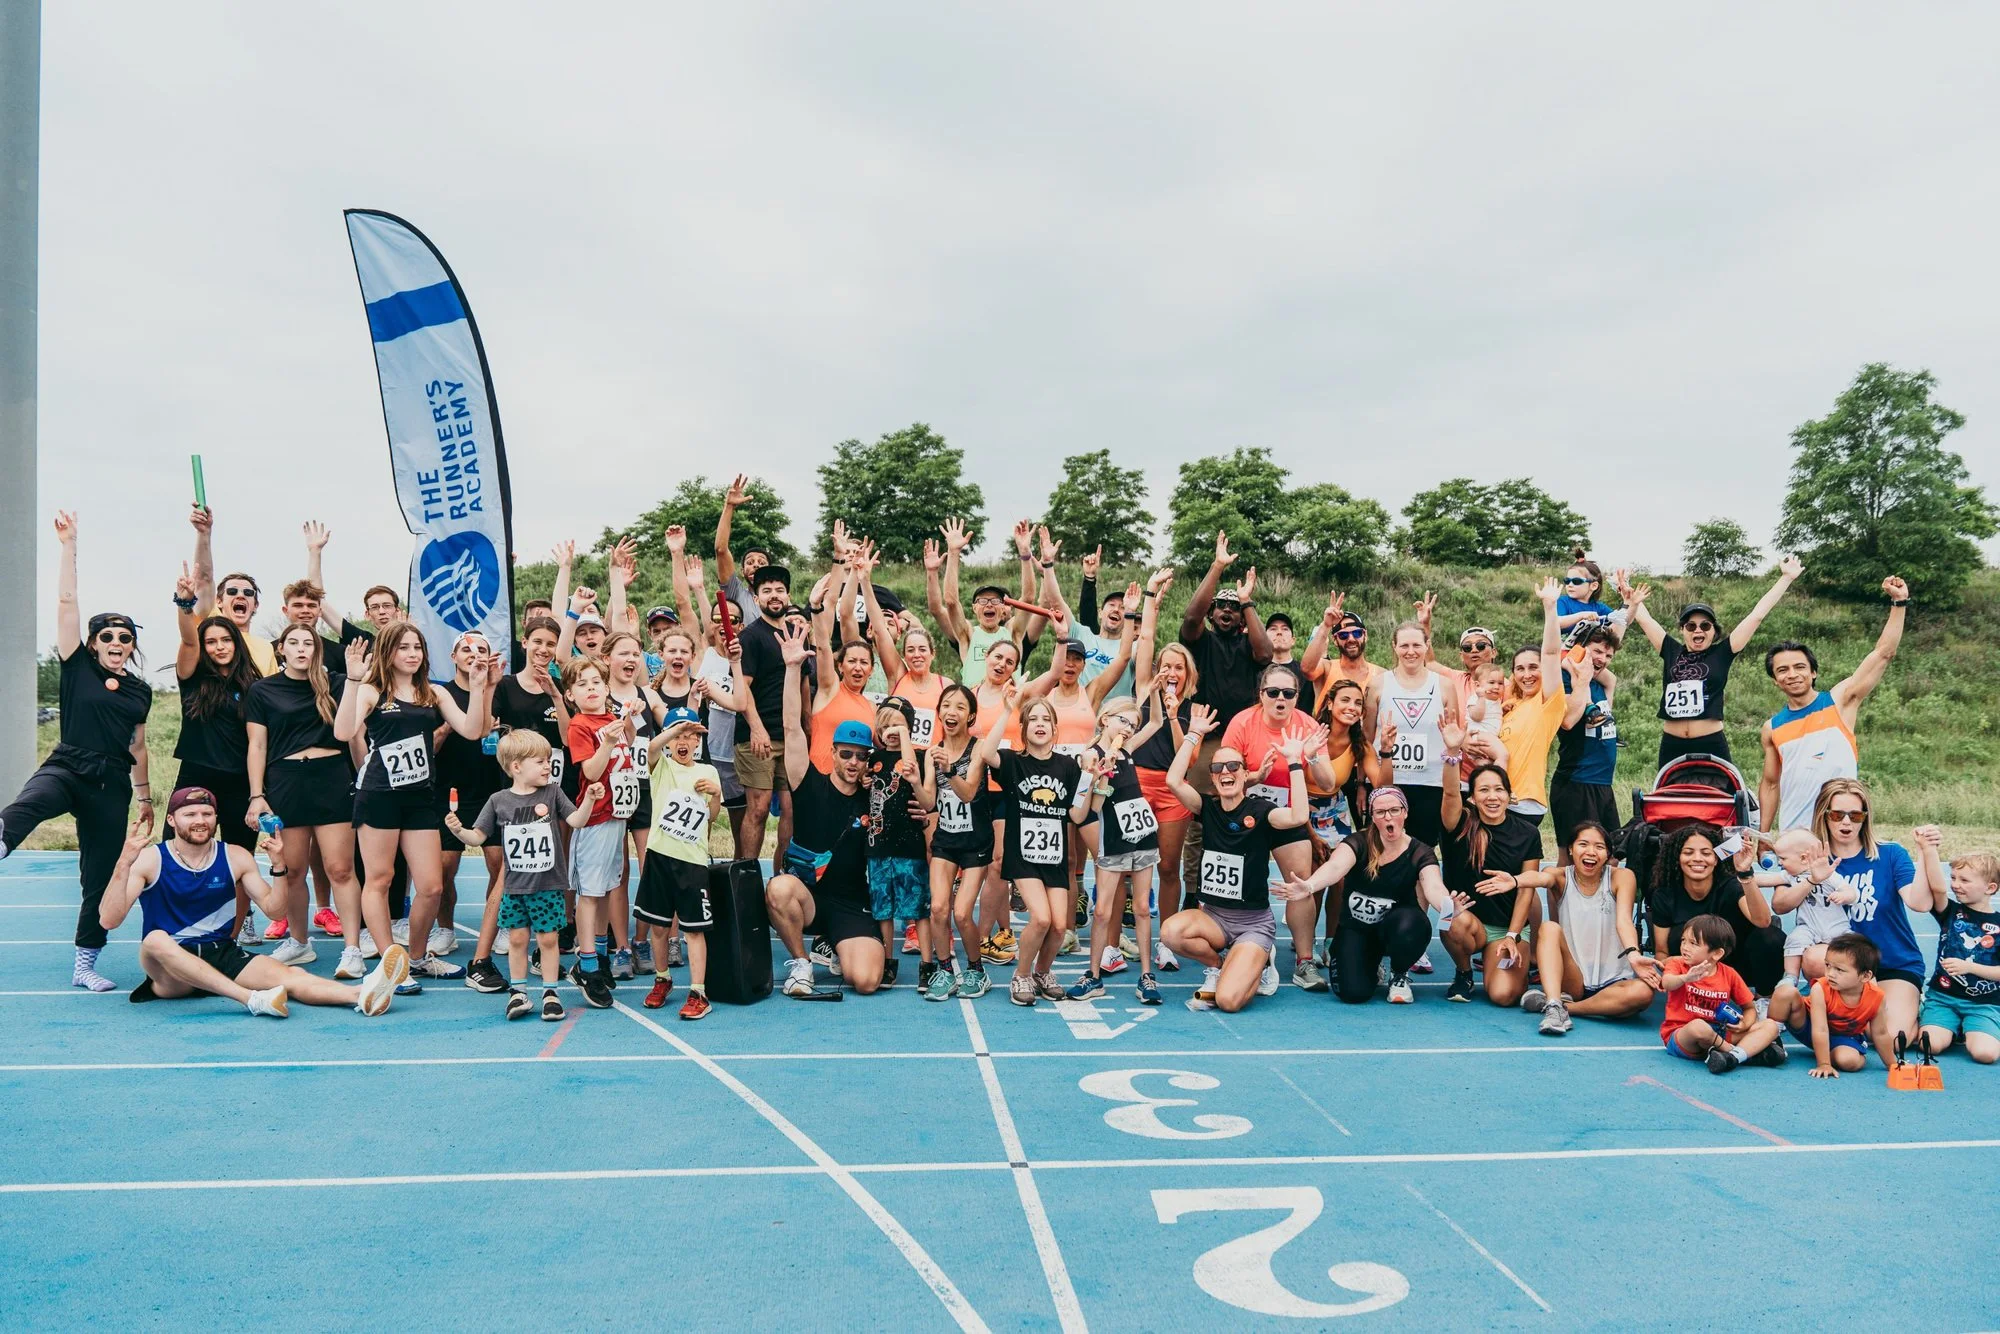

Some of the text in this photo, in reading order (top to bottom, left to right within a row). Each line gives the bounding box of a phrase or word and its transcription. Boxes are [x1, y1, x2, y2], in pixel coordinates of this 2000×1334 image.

[425, 379, 467, 520] RUNNER'S
[446, 381, 483, 513] ACADEMY
[417, 469, 444, 524] THE
[1667, 689, 1698, 708] 251
[911, 718, 932, 736] 89
[387, 747, 426, 775] 218
[1391, 743, 1424, 762] 200
[1018, 774, 1068, 801] BISONS
[662, 801, 706, 831] 247
[1019, 800, 1067, 816] TRACK CLUB
[1121, 808, 1154, 834] 236
[673, 829, 685, 838] FOR
[1023, 830, 1060, 852] 234
[508, 836, 551, 860] 244
[1203, 862, 1239, 887] 255
[700, 888, 713, 920] FILA
[1687, 985, 1728, 999] TORONTO
[1034, 995, 1159, 1040] 4
[1078, 1068, 1254, 1140] 3
[1150, 1185, 1411, 1318] 2
